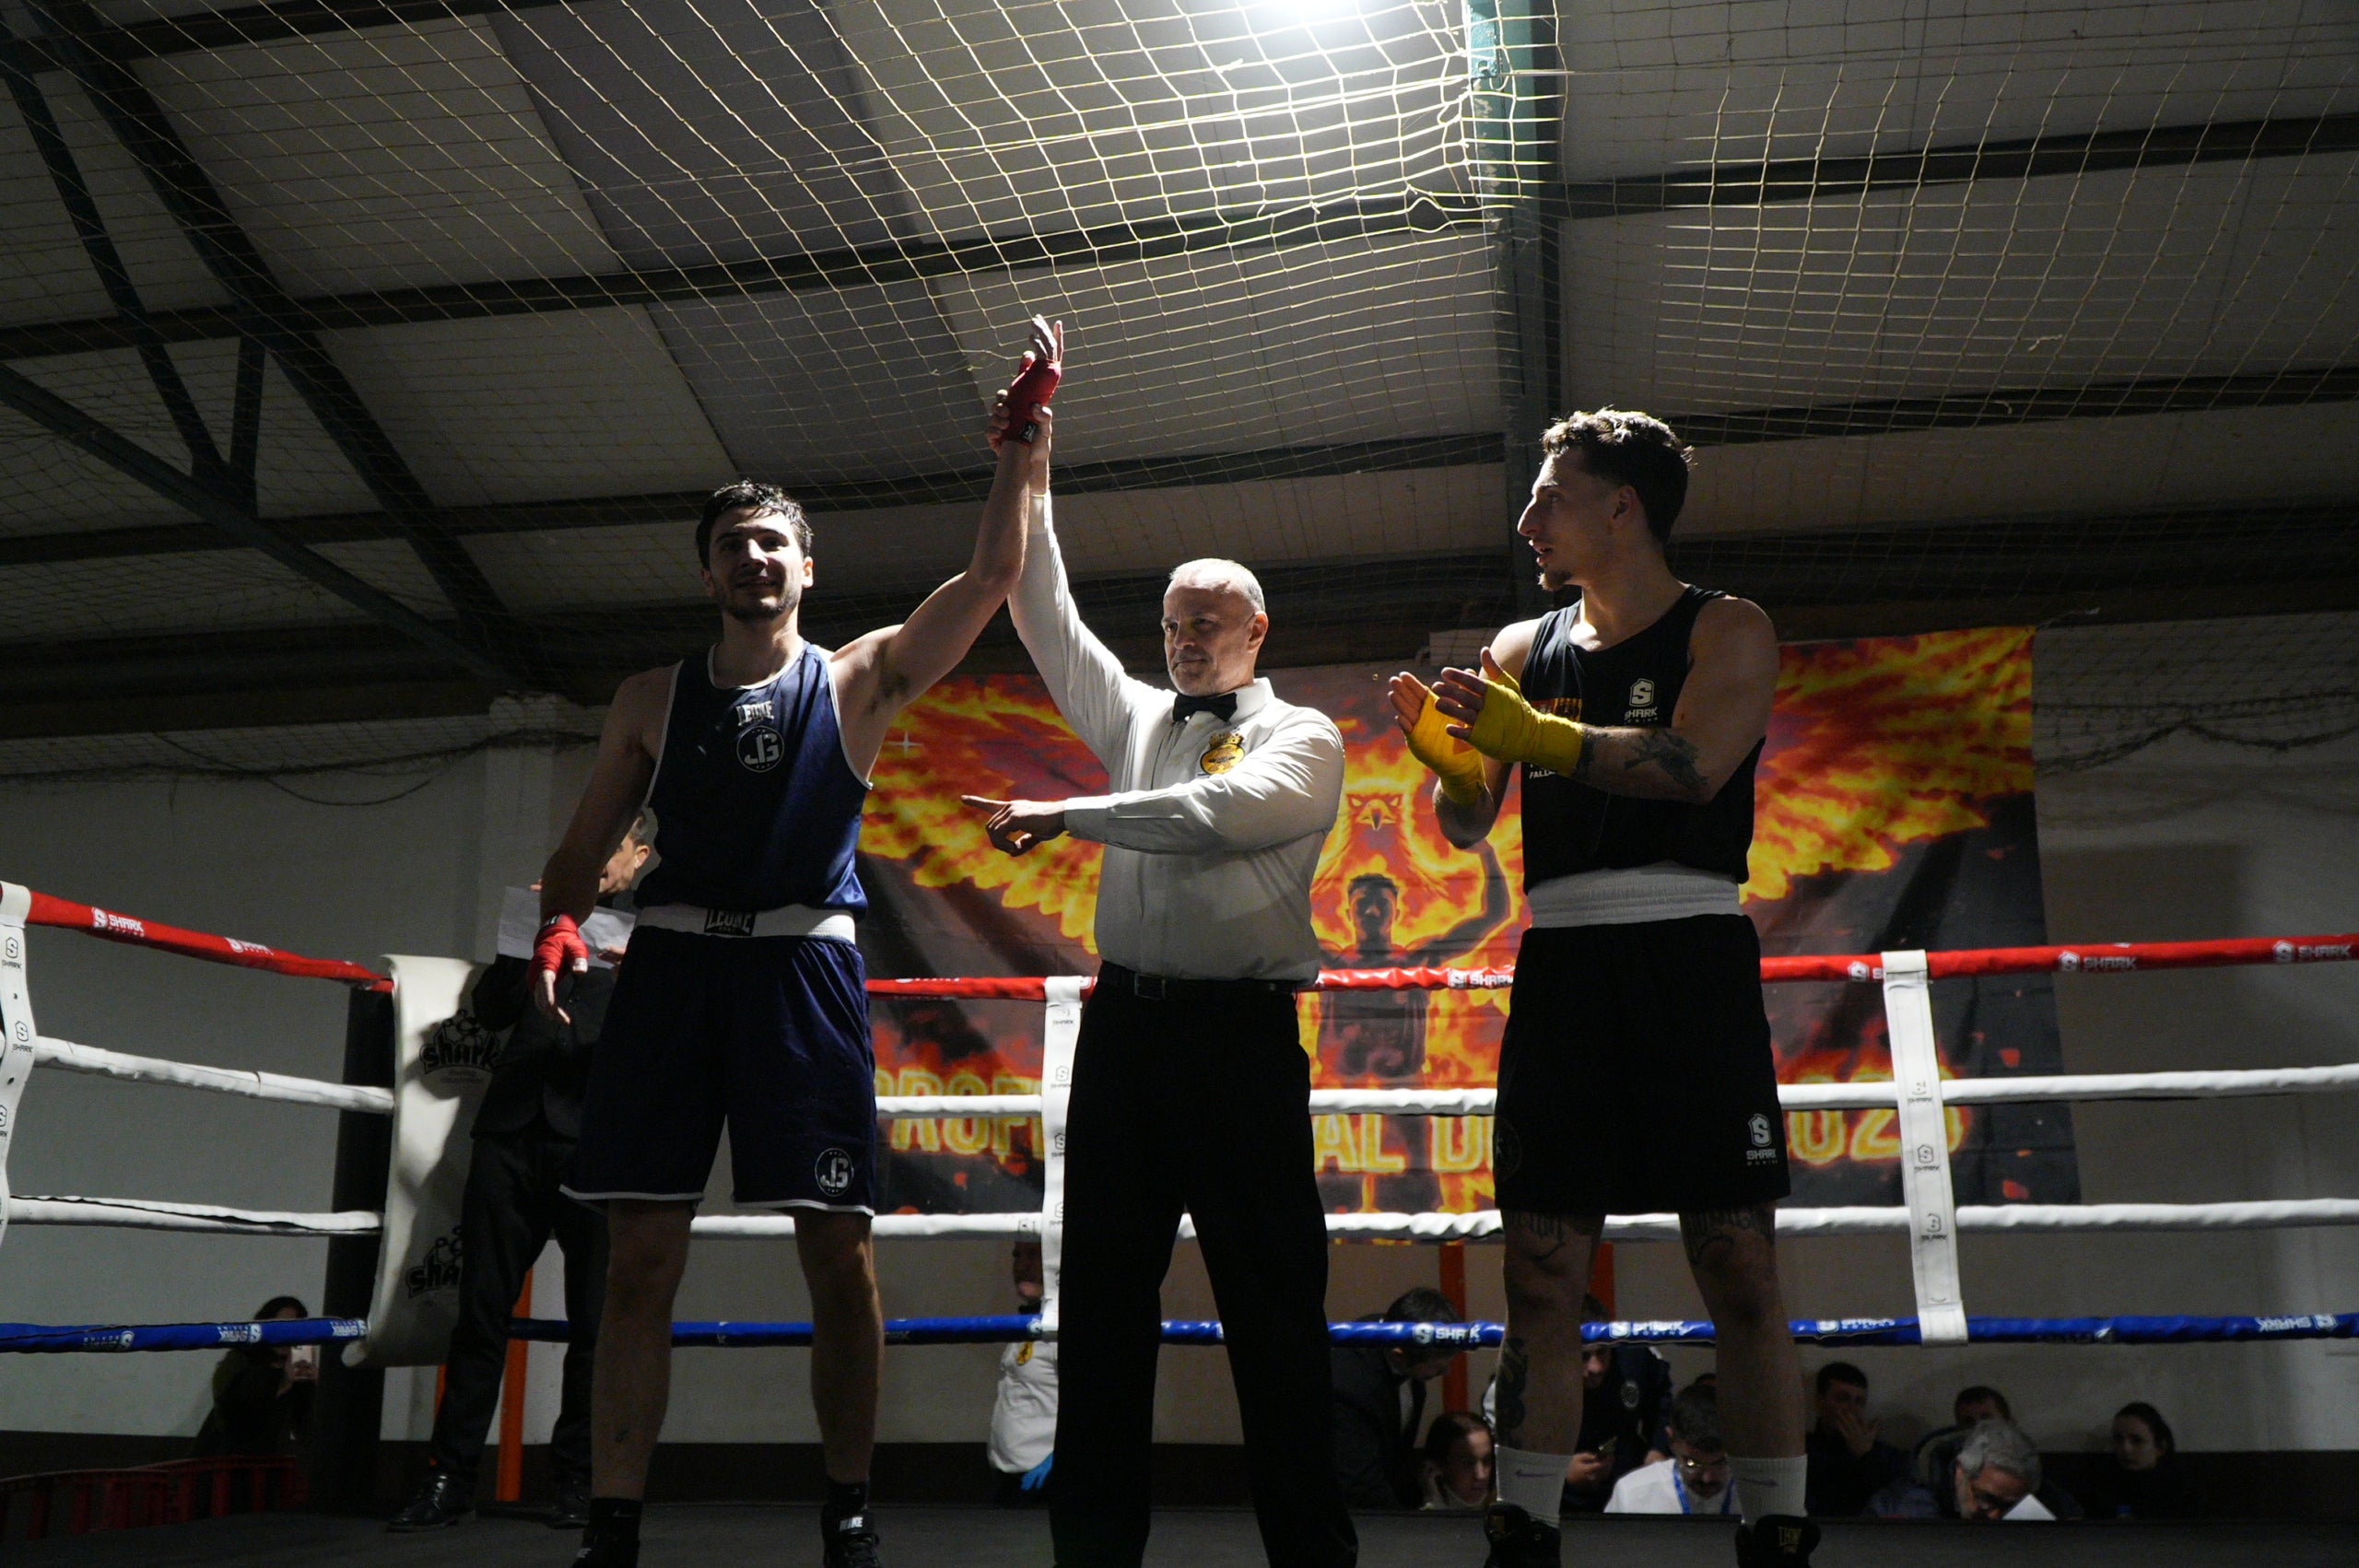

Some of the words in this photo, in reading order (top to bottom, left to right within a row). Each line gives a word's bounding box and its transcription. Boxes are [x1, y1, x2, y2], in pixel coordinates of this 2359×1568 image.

[1625, 707, 1659, 720] SHARK
[108, 914, 145, 932] SHARK
[2083, 955, 2137, 970] SHARK
[1746, 1148, 1777, 1160] SHARK
